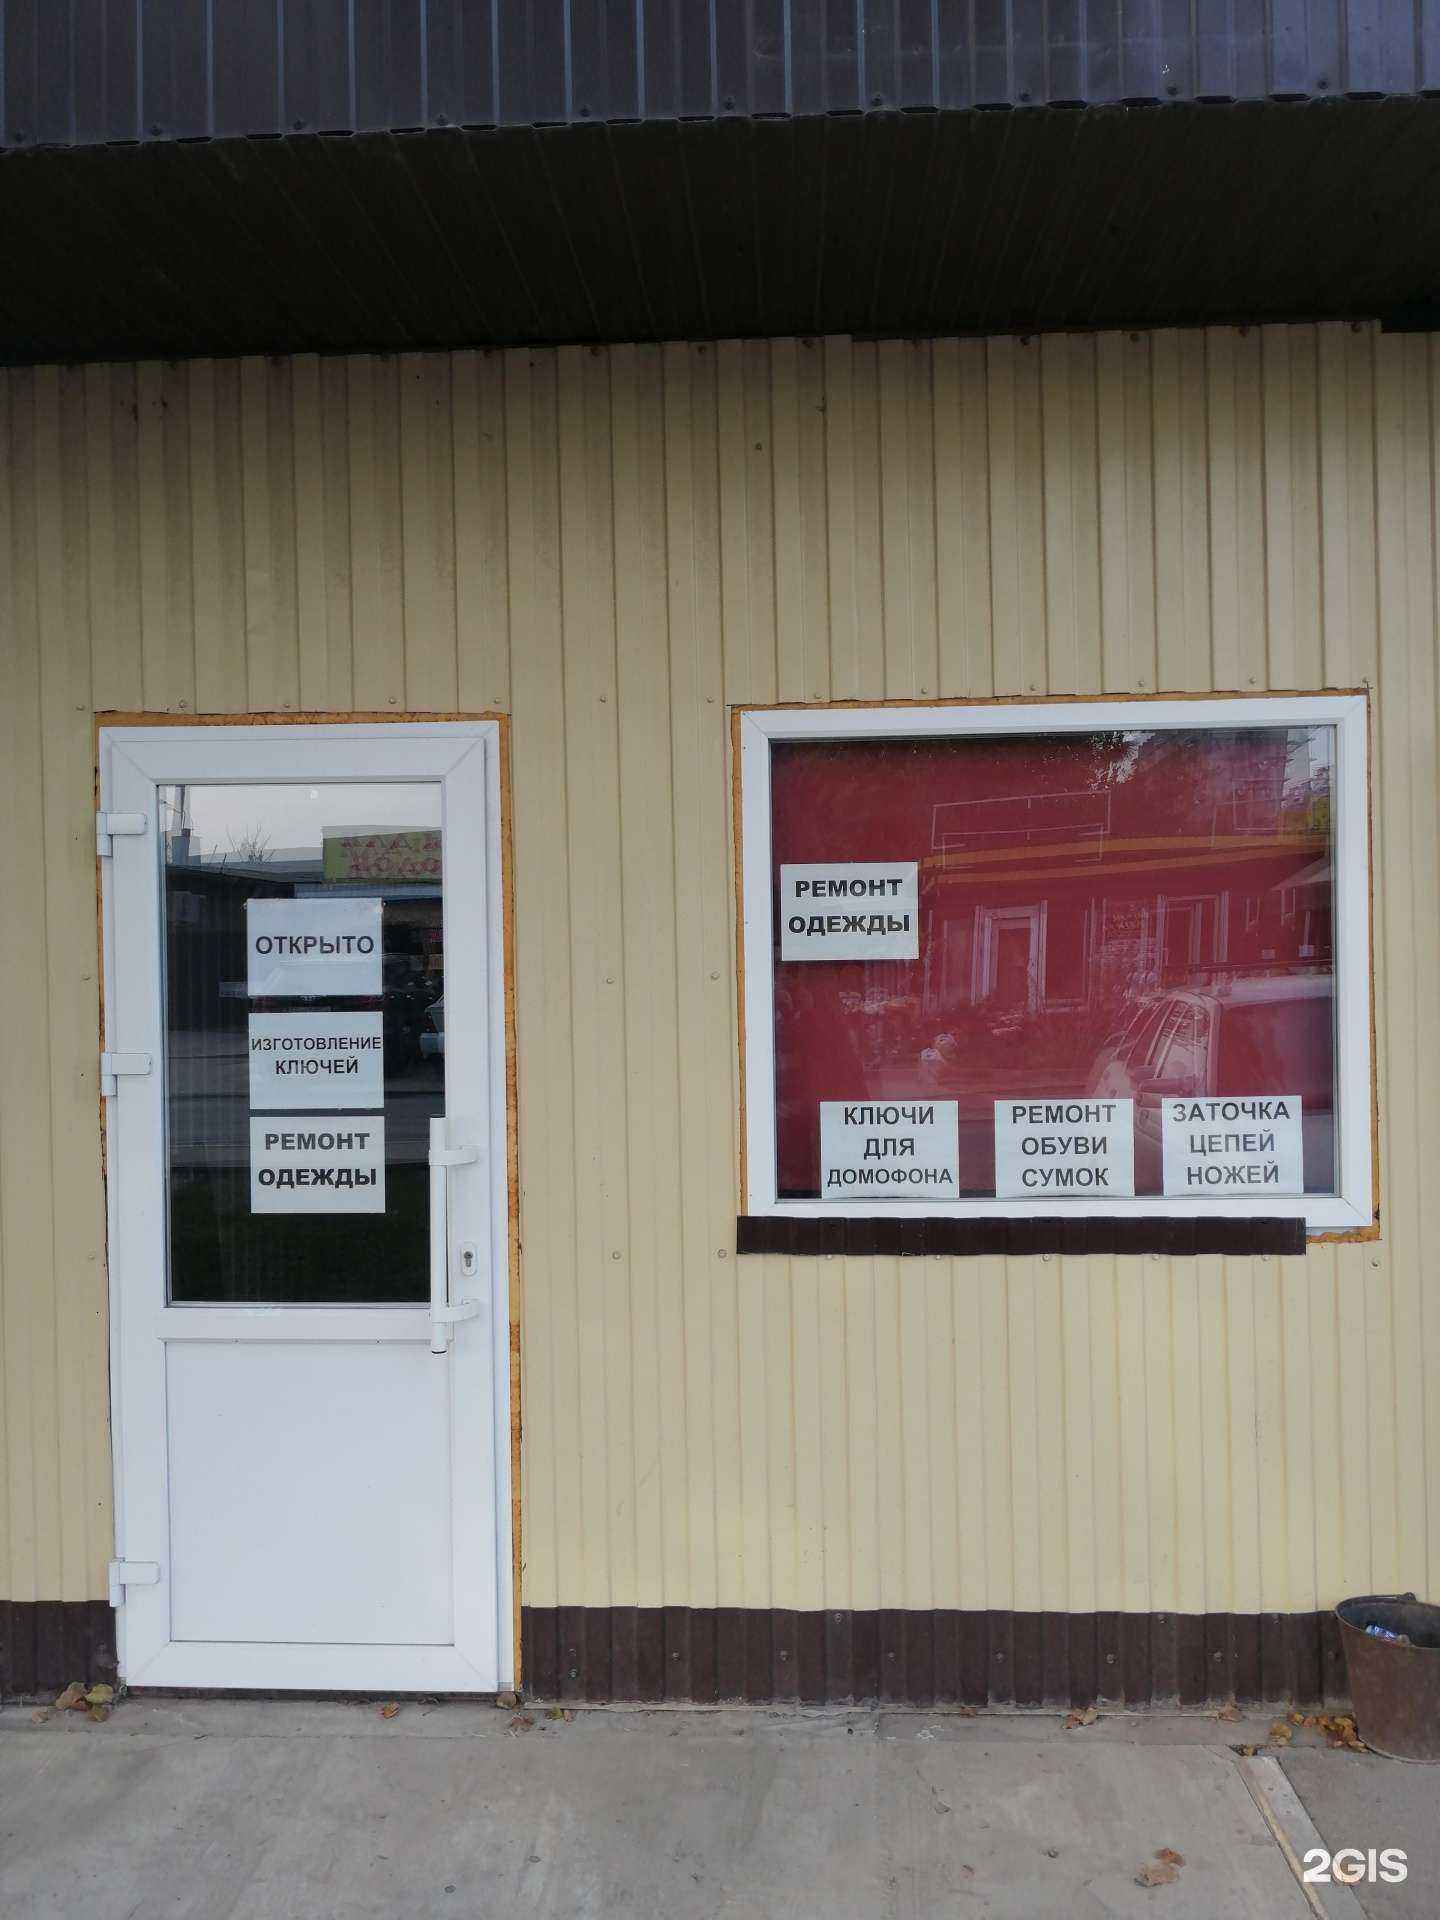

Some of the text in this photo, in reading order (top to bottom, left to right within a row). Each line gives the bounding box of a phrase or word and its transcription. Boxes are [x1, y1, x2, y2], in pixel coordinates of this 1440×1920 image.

[795, 878, 903, 898] РЕМОНТ
[788, 914, 910, 937] ОДЕЖДЫ
[256, 935, 375, 955] ОТКРЫТО
[251, 1036, 383, 1051] ИЗГОТОВЛЕНИЕ
[275, 1056, 359, 1075] КЛЮЧЕЙ
[844, 1106, 934, 1126] КЛЮЧИ
[1012, 1104, 1117, 1124] РЕМОНТ
[1172, 1101, 1291, 1122] ЗАТОЧКА
[265, 1132, 371, 1151] РЕМОНТ
[863, 1137, 915, 1161] ДЛЯ
[1021, 1136, 1107, 1156] ОБУВИ
[1189, 1129, 1275, 1157] ЦЕПЕЙ
[258, 1168, 377, 1190] ОДЕЖДЫ
[826, 1167, 953, 1188] ДОМОФОНА
[1021, 1167, 1109, 1188] СУМОК
[1187, 1159, 1279, 1186] НОЖЕЙ
